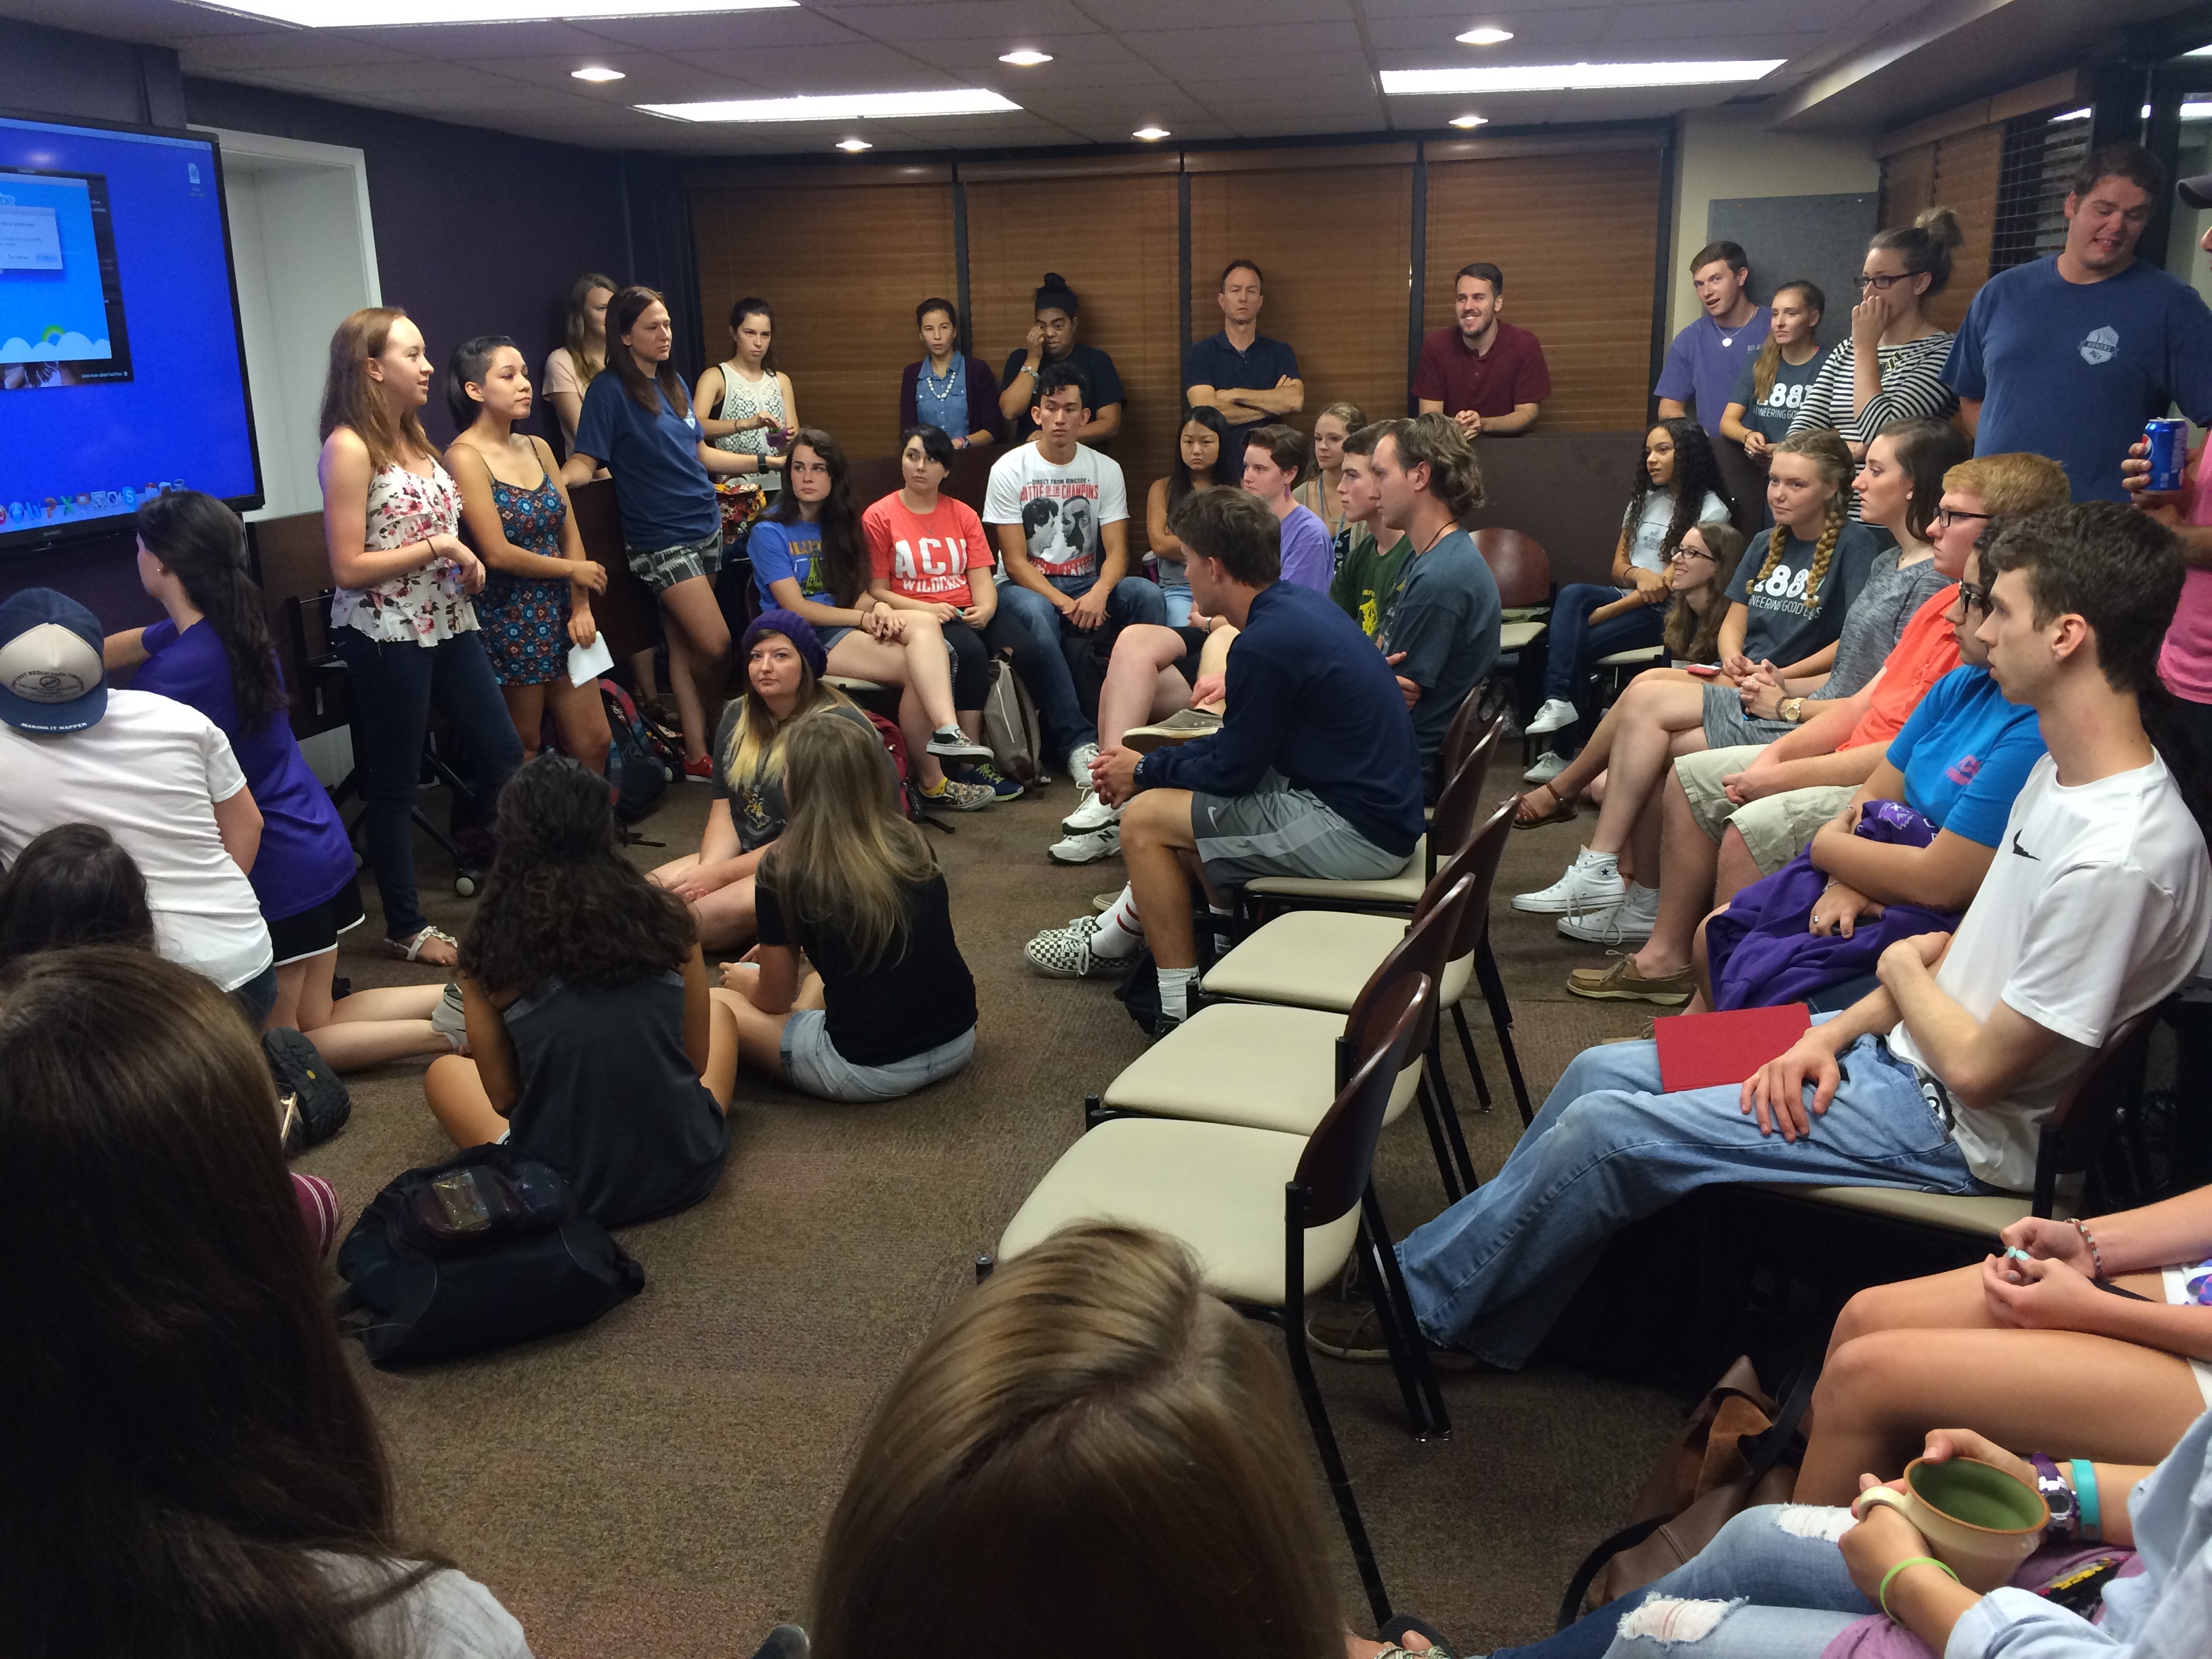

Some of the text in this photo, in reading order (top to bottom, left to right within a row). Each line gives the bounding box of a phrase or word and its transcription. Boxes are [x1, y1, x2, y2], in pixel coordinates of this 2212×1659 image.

[1757, 383, 1814, 409] 881
[1787, 409, 1799, 419] GO
[895, 537, 967, 579] ACU
[1782, 600, 1803, 614] GOOD
[59, 722, 87, 730] HAPPEN
